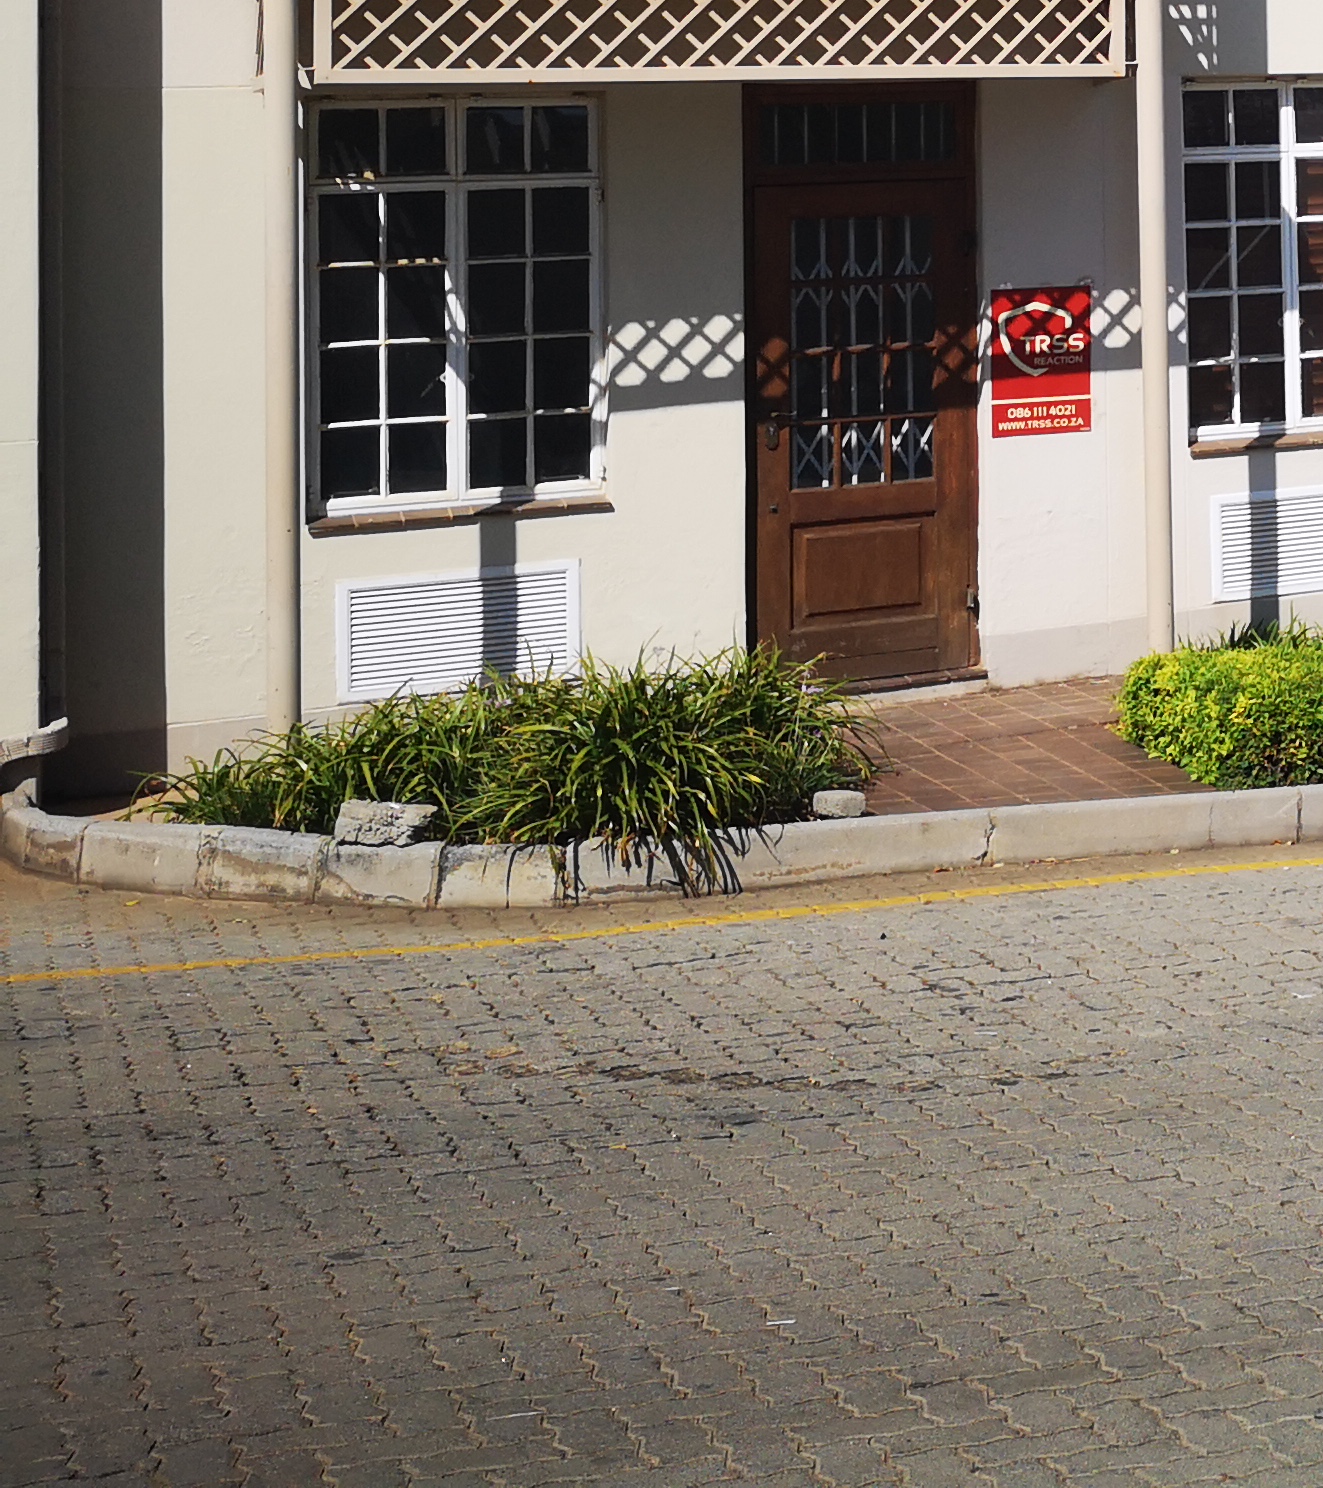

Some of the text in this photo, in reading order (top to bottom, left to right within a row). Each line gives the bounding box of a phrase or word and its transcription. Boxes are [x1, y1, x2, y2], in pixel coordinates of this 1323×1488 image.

[1019, 333, 1085, 355] TRSS
[1033, 355, 1083, 366] REACTION
[1007, 404, 1076, 419] 086 111 4021
[998, 416, 1084, 431] WWW.TRSS.CO.ZA
